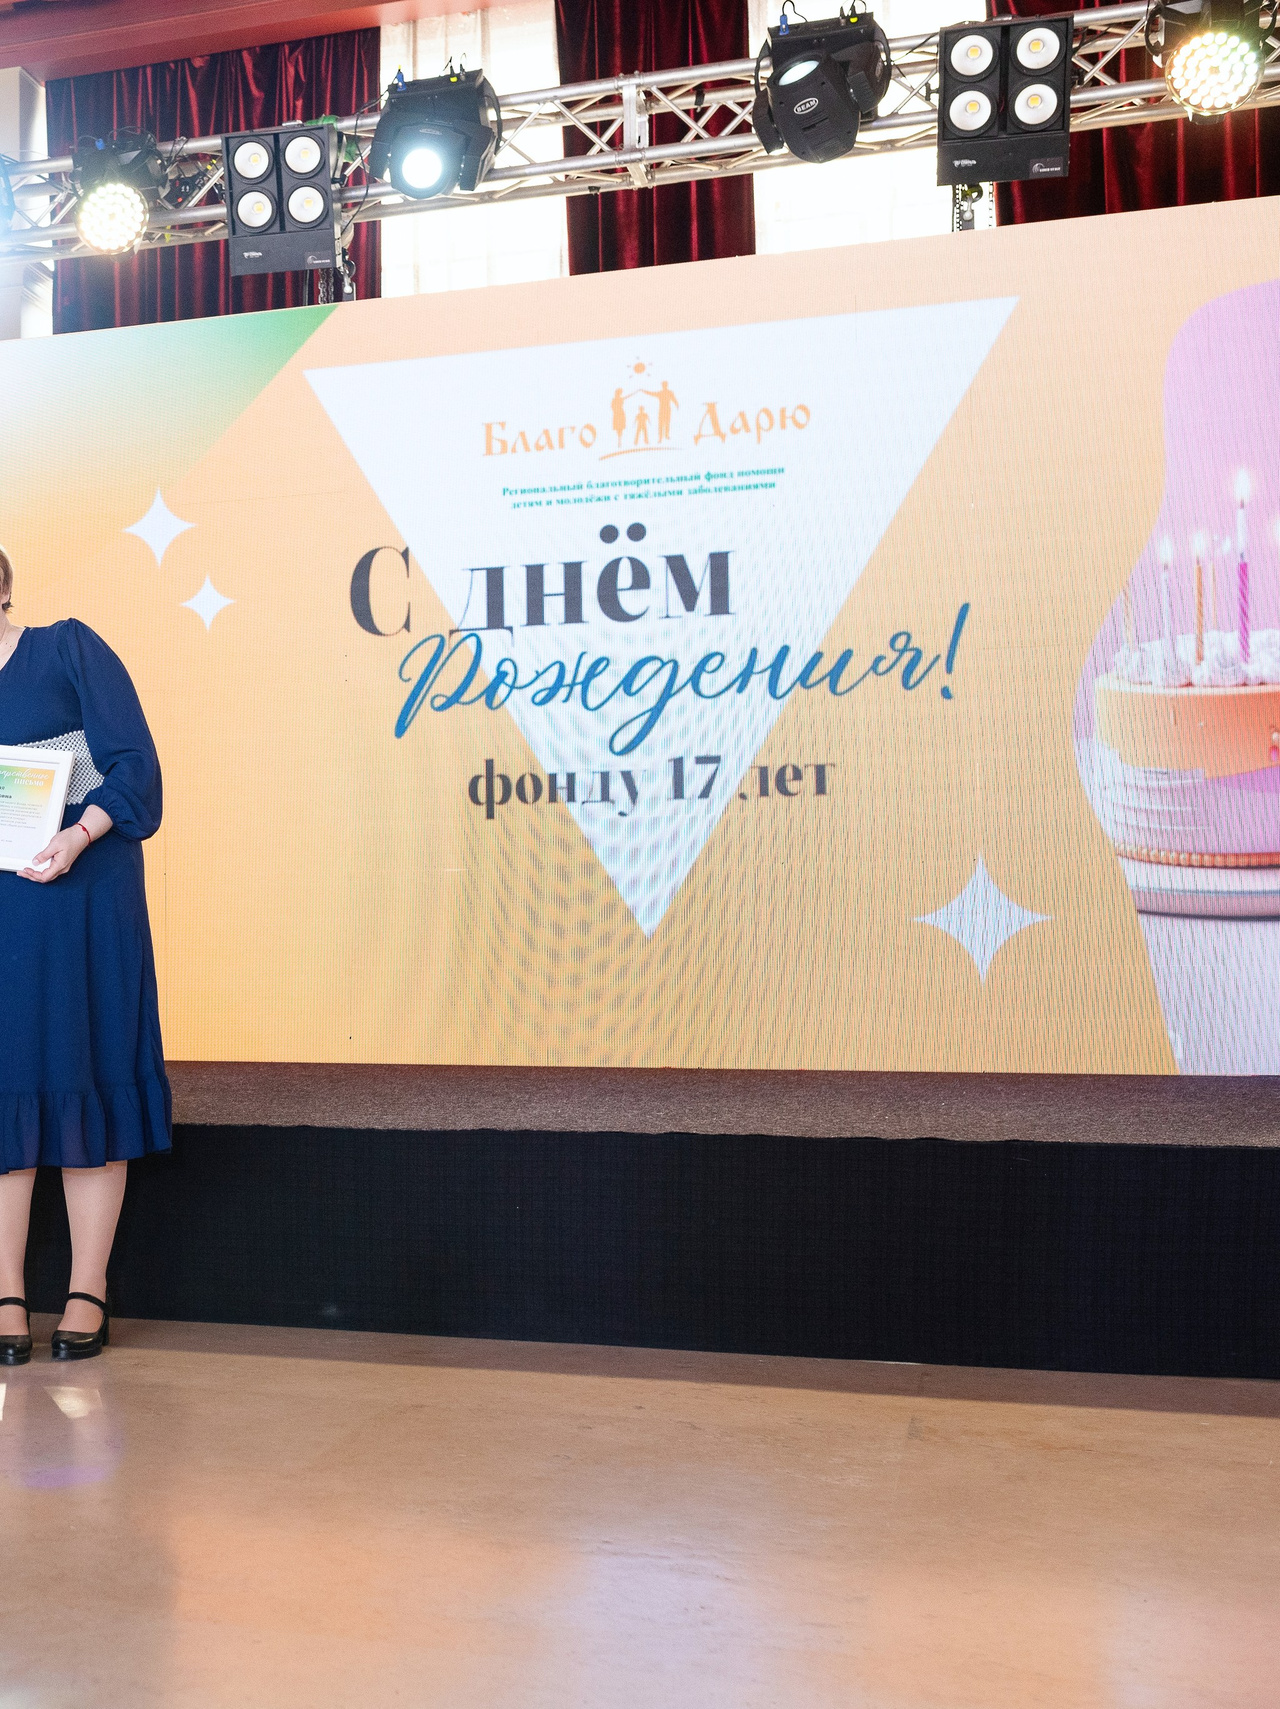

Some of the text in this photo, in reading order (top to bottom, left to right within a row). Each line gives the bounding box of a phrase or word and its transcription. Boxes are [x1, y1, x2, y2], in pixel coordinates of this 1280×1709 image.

[796, 100, 816, 112] BEAM
[482, 401, 811, 456] Благо Дарю
[502, 467, 785, 496] Региональный благотворительный фонд помощи
[512, 499, 542, 509] детям
[556, 494, 611, 505] молодёжи
[624, 488, 683, 500] тяжёлыми
[688, 482, 776, 495] заболеваниями
[350, 522, 736, 647] С днём
[394, 603, 970, 757] Рождения!
[14, 778, 44, 787] письмо
[468, 755, 836, 820] фонду 17 лет
